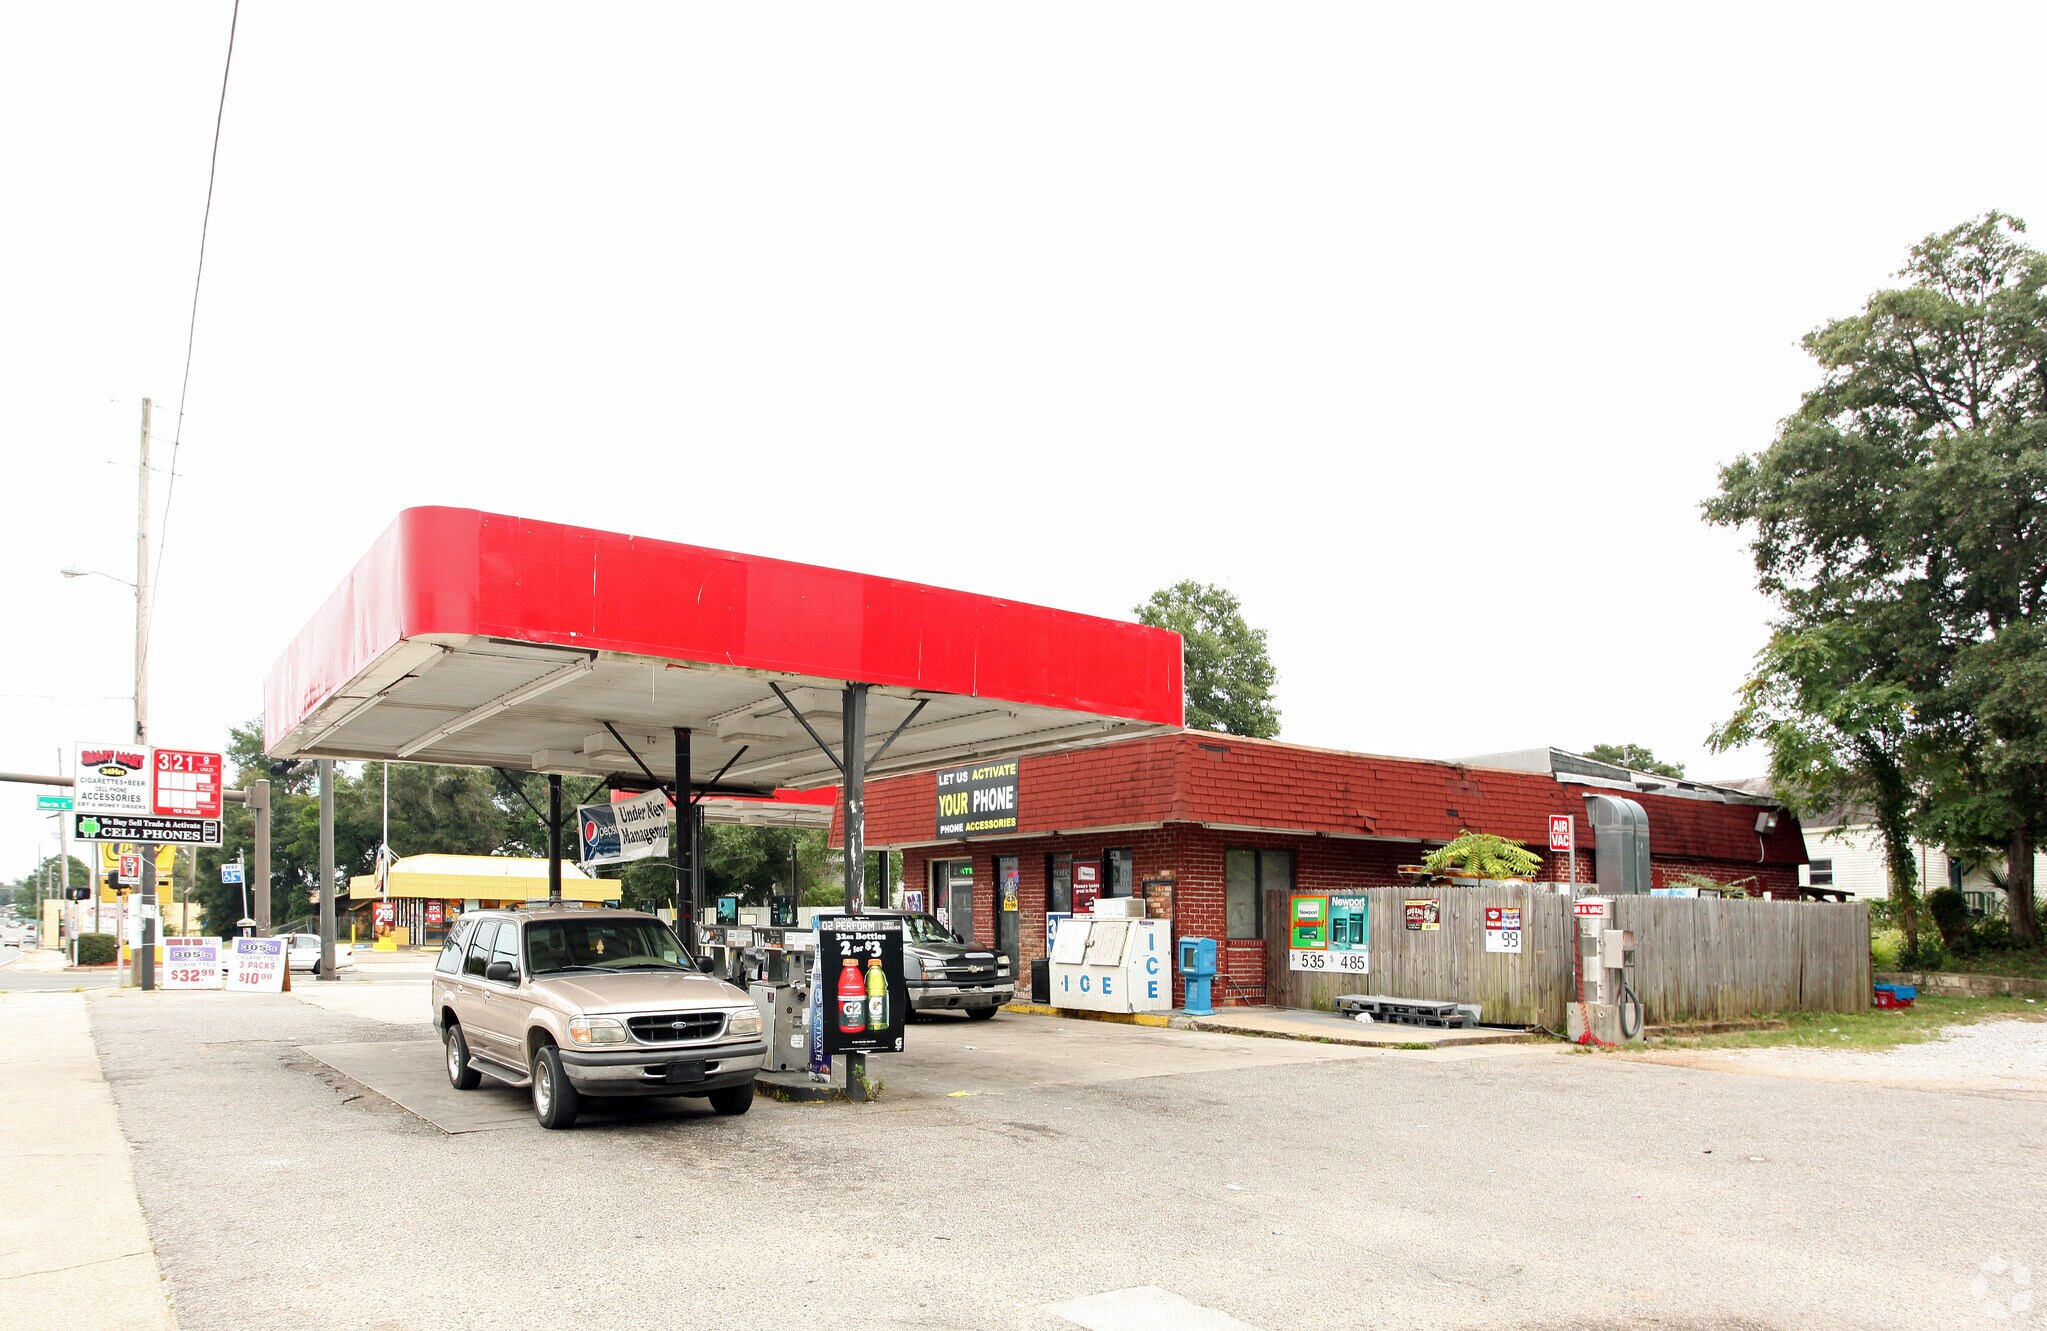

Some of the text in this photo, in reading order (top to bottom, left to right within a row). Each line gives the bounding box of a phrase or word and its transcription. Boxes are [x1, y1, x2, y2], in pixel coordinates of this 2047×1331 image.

[81, 750, 145, 770] SMART MART
[938, 763, 1017, 786] LET US ACTIVATE
[81, 792, 141, 802] ACCESSORIES
[938, 785, 1014, 817] YOUR PHONE
[618, 803, 646, 823] Under
[113, 818, 126, 828] Buy
[128, 819, 142, 827] Sell
[145, 820, 162, 828] Trade
[173, 822, 201, 830] Activate
[940, 817, 1017, 834] PHONE ACCESSORIES
[1553, 820, 1568, 832] AIR
[101, 827, 140, 838] CELL
[142, 829, 201, 841] PHONES
[1551, 834, 1570, 847] VAC
[1332, 896, 1366, 907] Newport
[1588, 906, 1603, 914] VAC
[822, 921, 875, 931] 02 PERFORM
[855, 932, 887, 940] Bottles
[840, 940, 883, 958] 2 for $3
[247, 961, 276, 970] PACKS
[1064, 974, 1112, 995] ICE
[843, 1002, 861, 1016] G2
